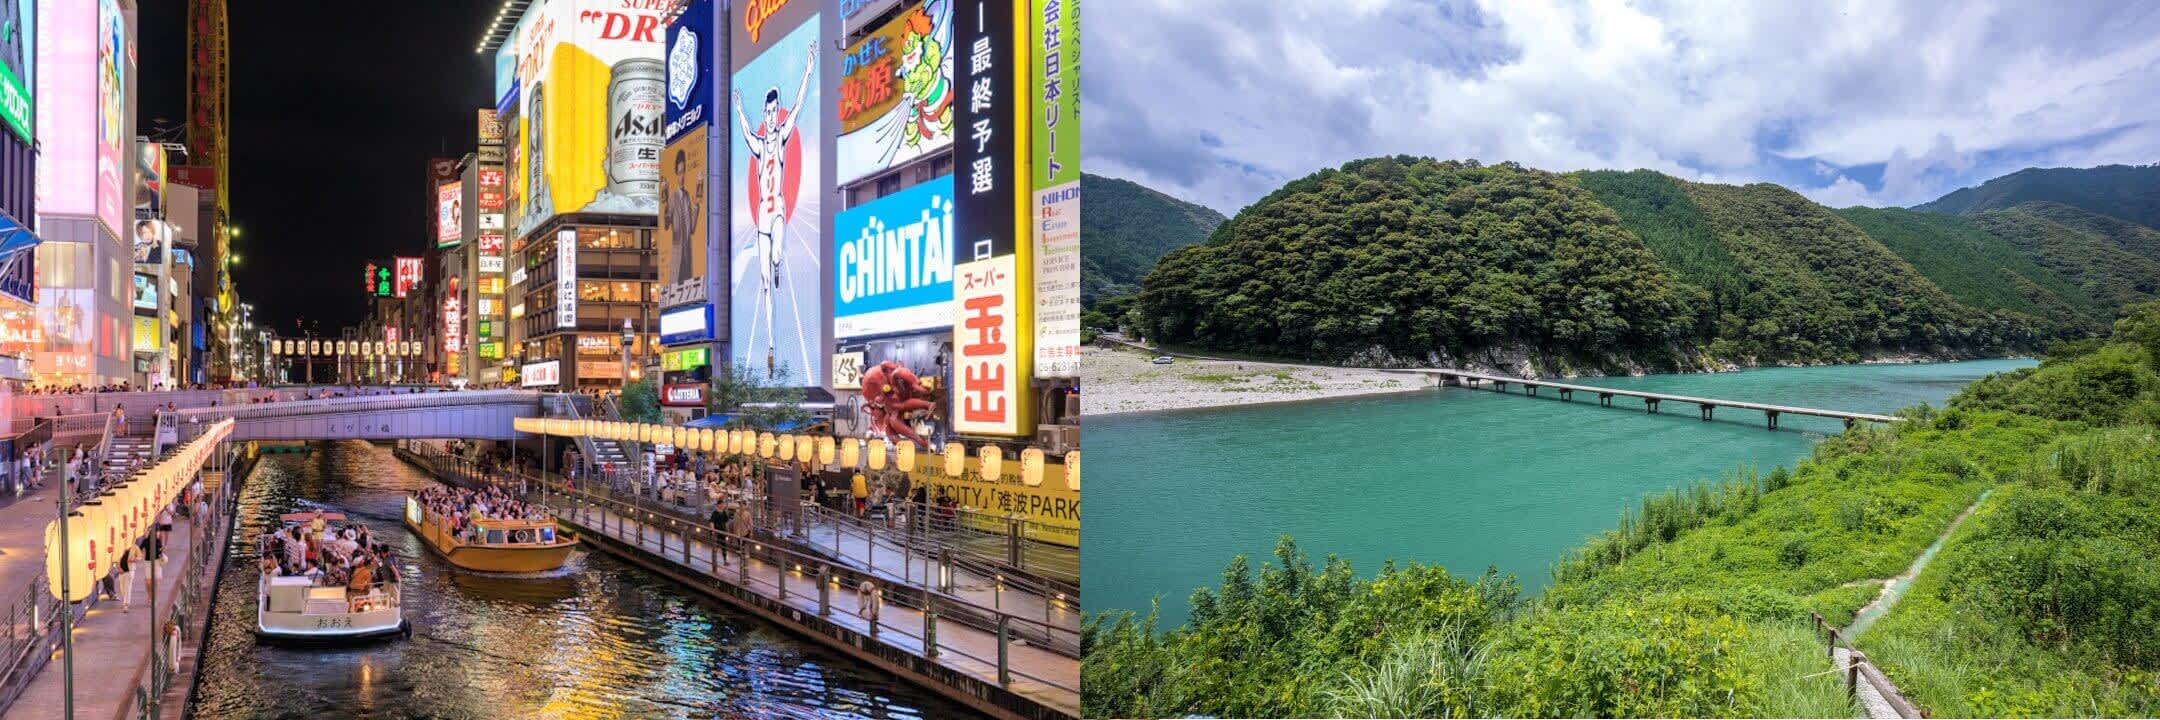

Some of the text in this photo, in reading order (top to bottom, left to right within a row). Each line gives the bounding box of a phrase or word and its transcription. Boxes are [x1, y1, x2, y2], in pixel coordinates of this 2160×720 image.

[837, 57, 894, 121] 改源
[638, 147, 656, 160] 生
[964, 267, 1005, 290] スーパー
[963, 293, 1007, 423] 玉出
[675, 387, 700, 399] LOTTERIA
